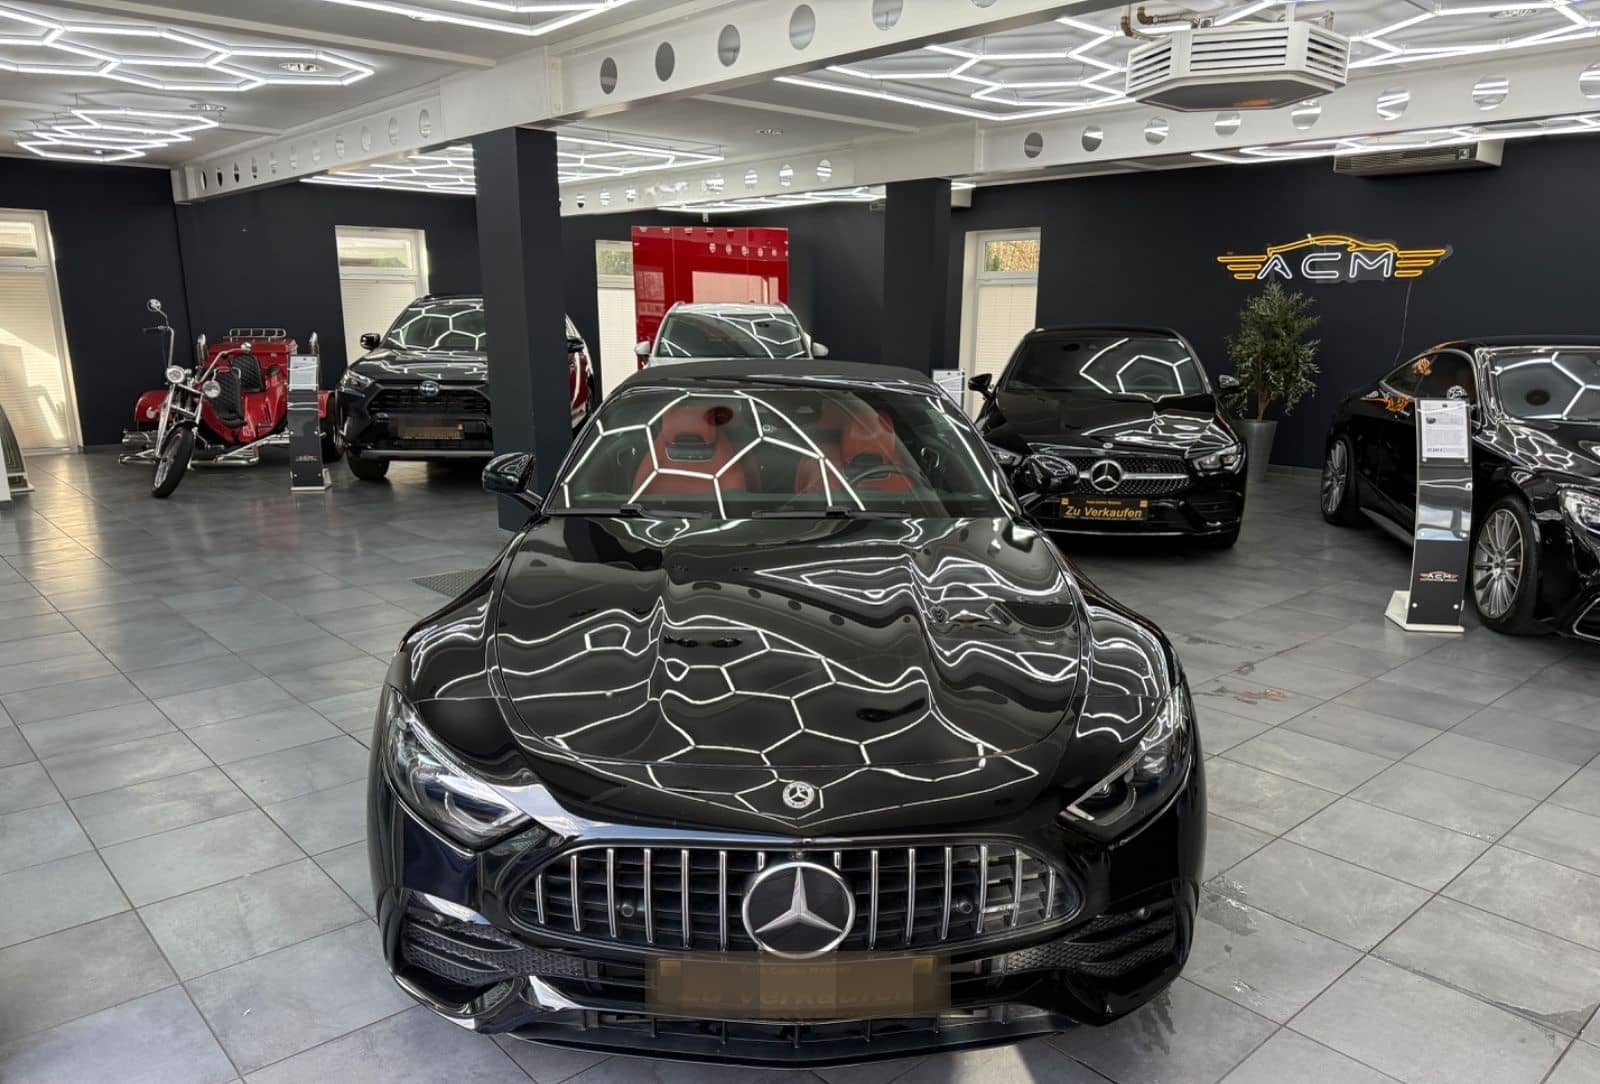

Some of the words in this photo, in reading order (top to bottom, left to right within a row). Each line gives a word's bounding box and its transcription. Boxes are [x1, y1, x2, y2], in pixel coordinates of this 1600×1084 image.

[1257, 251, 1394, 279] ACM
[1065, 506, 1081, 516] Zu
[1084, 507, 1142, 518] Verkaufen
